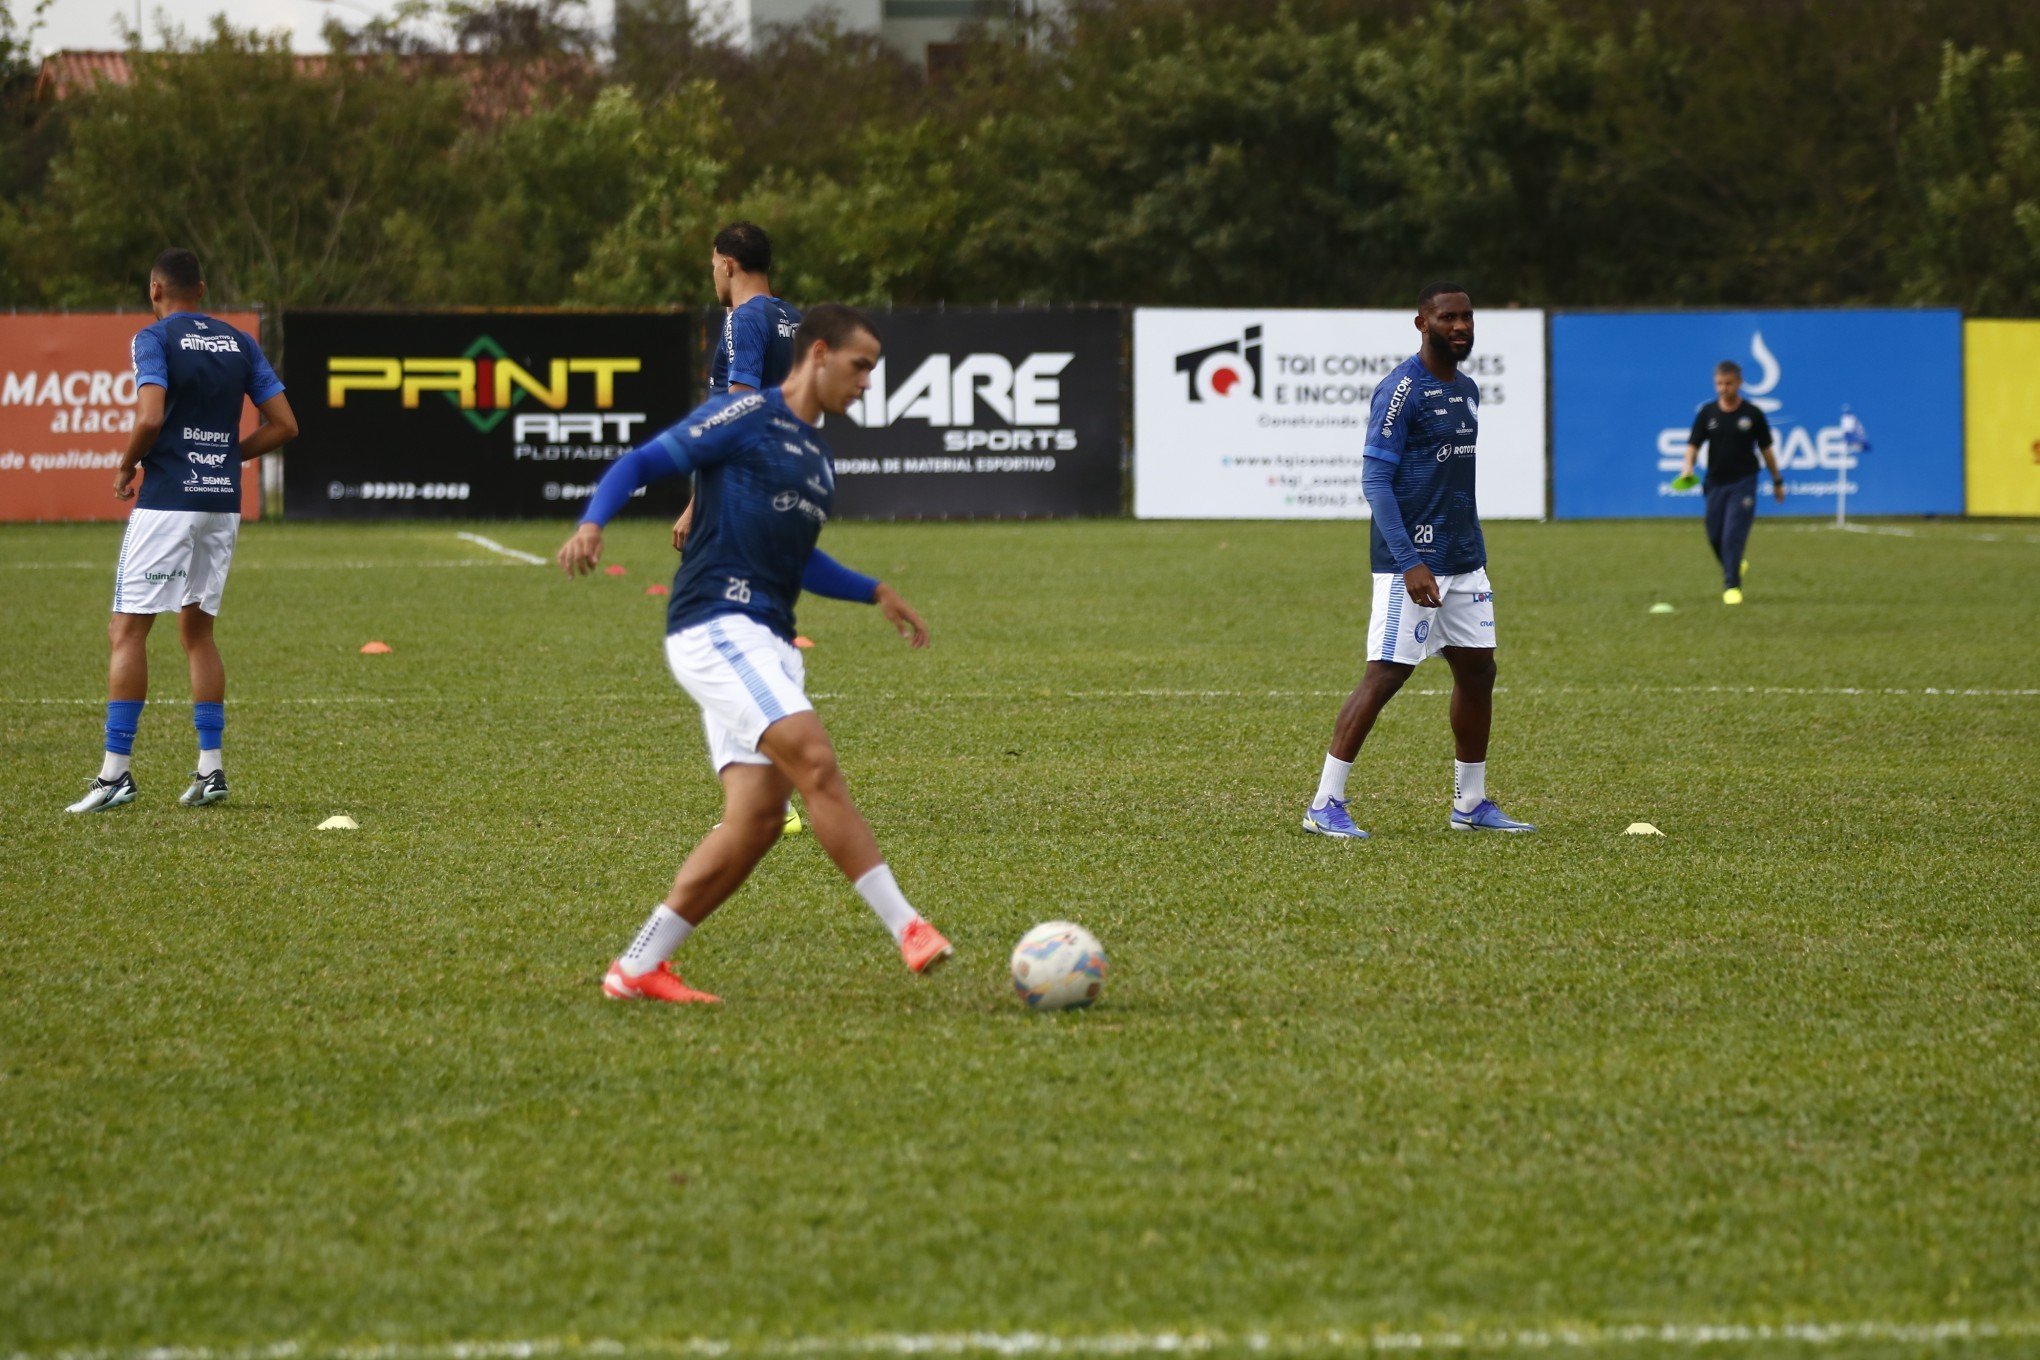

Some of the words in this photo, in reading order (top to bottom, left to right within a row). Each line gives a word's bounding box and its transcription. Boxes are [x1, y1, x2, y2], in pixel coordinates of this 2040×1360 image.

[327, 357, 642, 409] PRINT
[1383, 376, 1412, 427] VINCITORE
[514, 412, 647, 443] ART
[943, 429, 1077, 452] SPORTS
[882, 458, 900, 474] DE
[903, 457, 973, 473] MATERIAL
[975, 456, 1056, 472] ESPORTIVO
[1414, 524, 1434, 544] 28
[724, 576, 752, 604] 26
